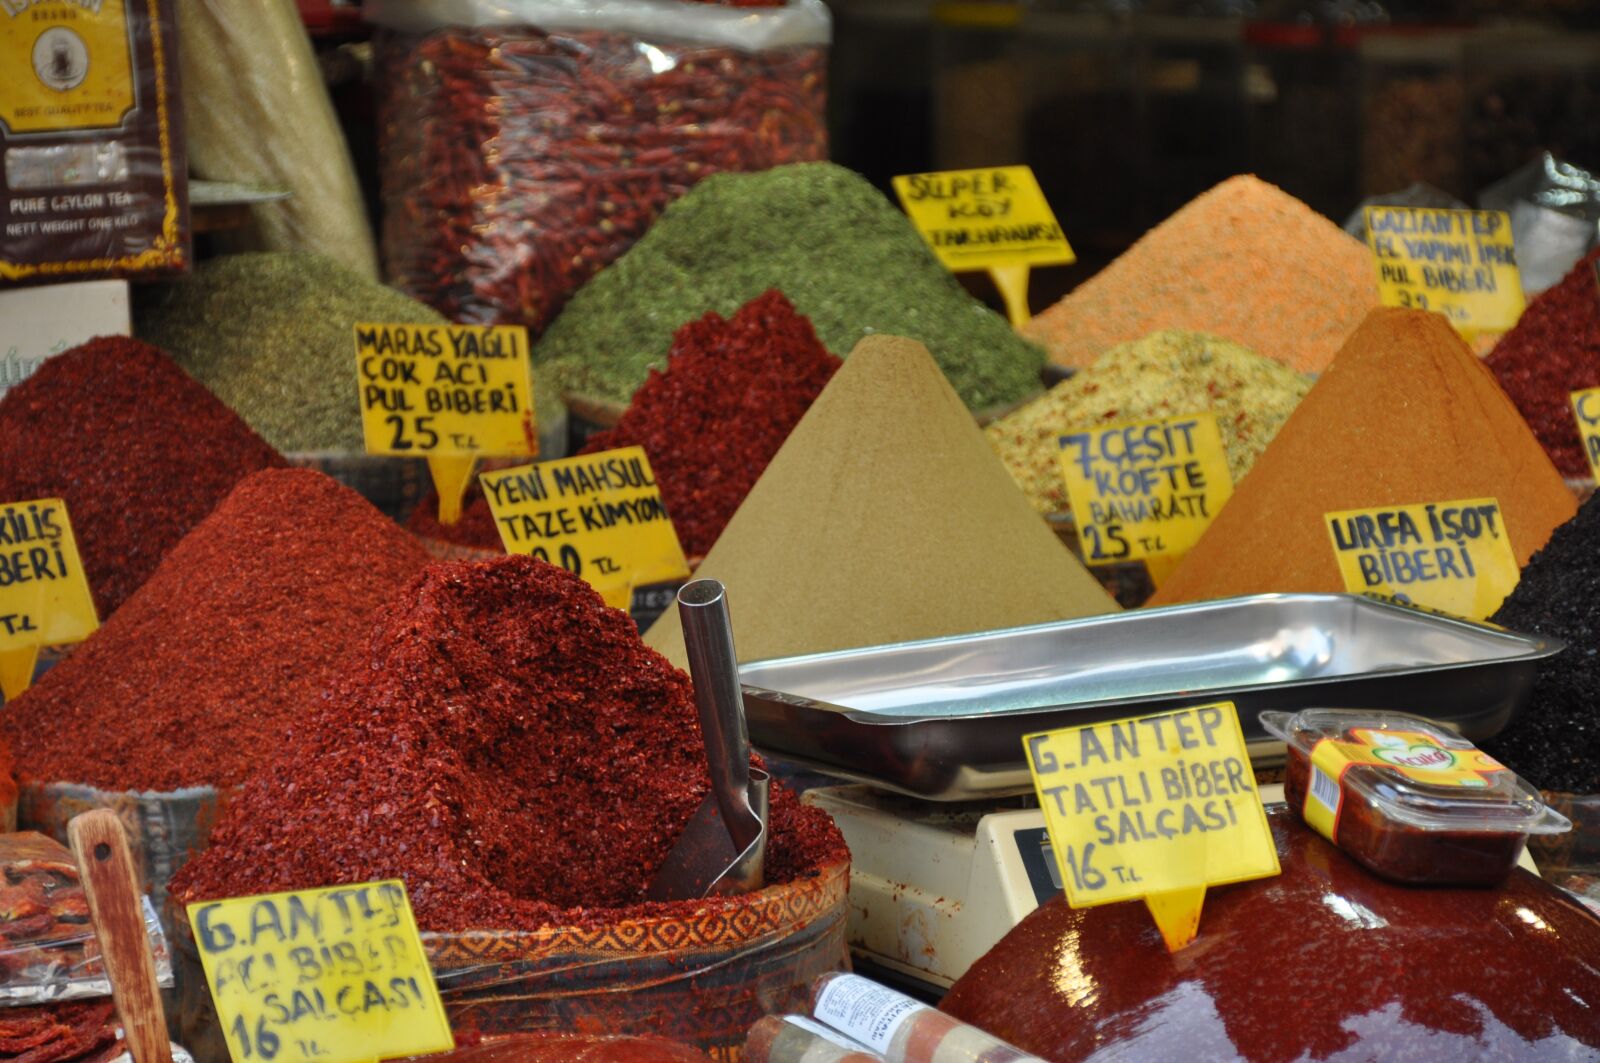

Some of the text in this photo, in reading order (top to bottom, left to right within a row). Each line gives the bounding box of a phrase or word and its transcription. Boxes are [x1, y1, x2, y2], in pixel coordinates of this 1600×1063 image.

[10, 191, 131, 214] PURE CEYLON TEA
[6, 221, 36, 236] NETT
[39, 218, 85, 234] WEIGHT
[88, 216, 111, 229] ONE
[1381, 263, 1416, 285] PUL
[434, 361, 487, 385] ACI
[365, 382, 518, 414] PUL BİBERİ
[385, 415, 439, 449] 25
[1058, 432, 1098, 480] 7
[485, 464, 548, 506] YENİ
[501, 507, 577, 541] TAZE
[1083, 524, 1131, 559] 25
[1332, 510, 1423, 550] URFA
[1358, 541, 1476, 587] BİBERİ
[1043, 758, 1254, 817] TATLI BİBER
[1094, 799, 1238, 845] SALÇASI
[1067, 842, 1108, 892] 16
[231, 1013, 280, 1060] 16
